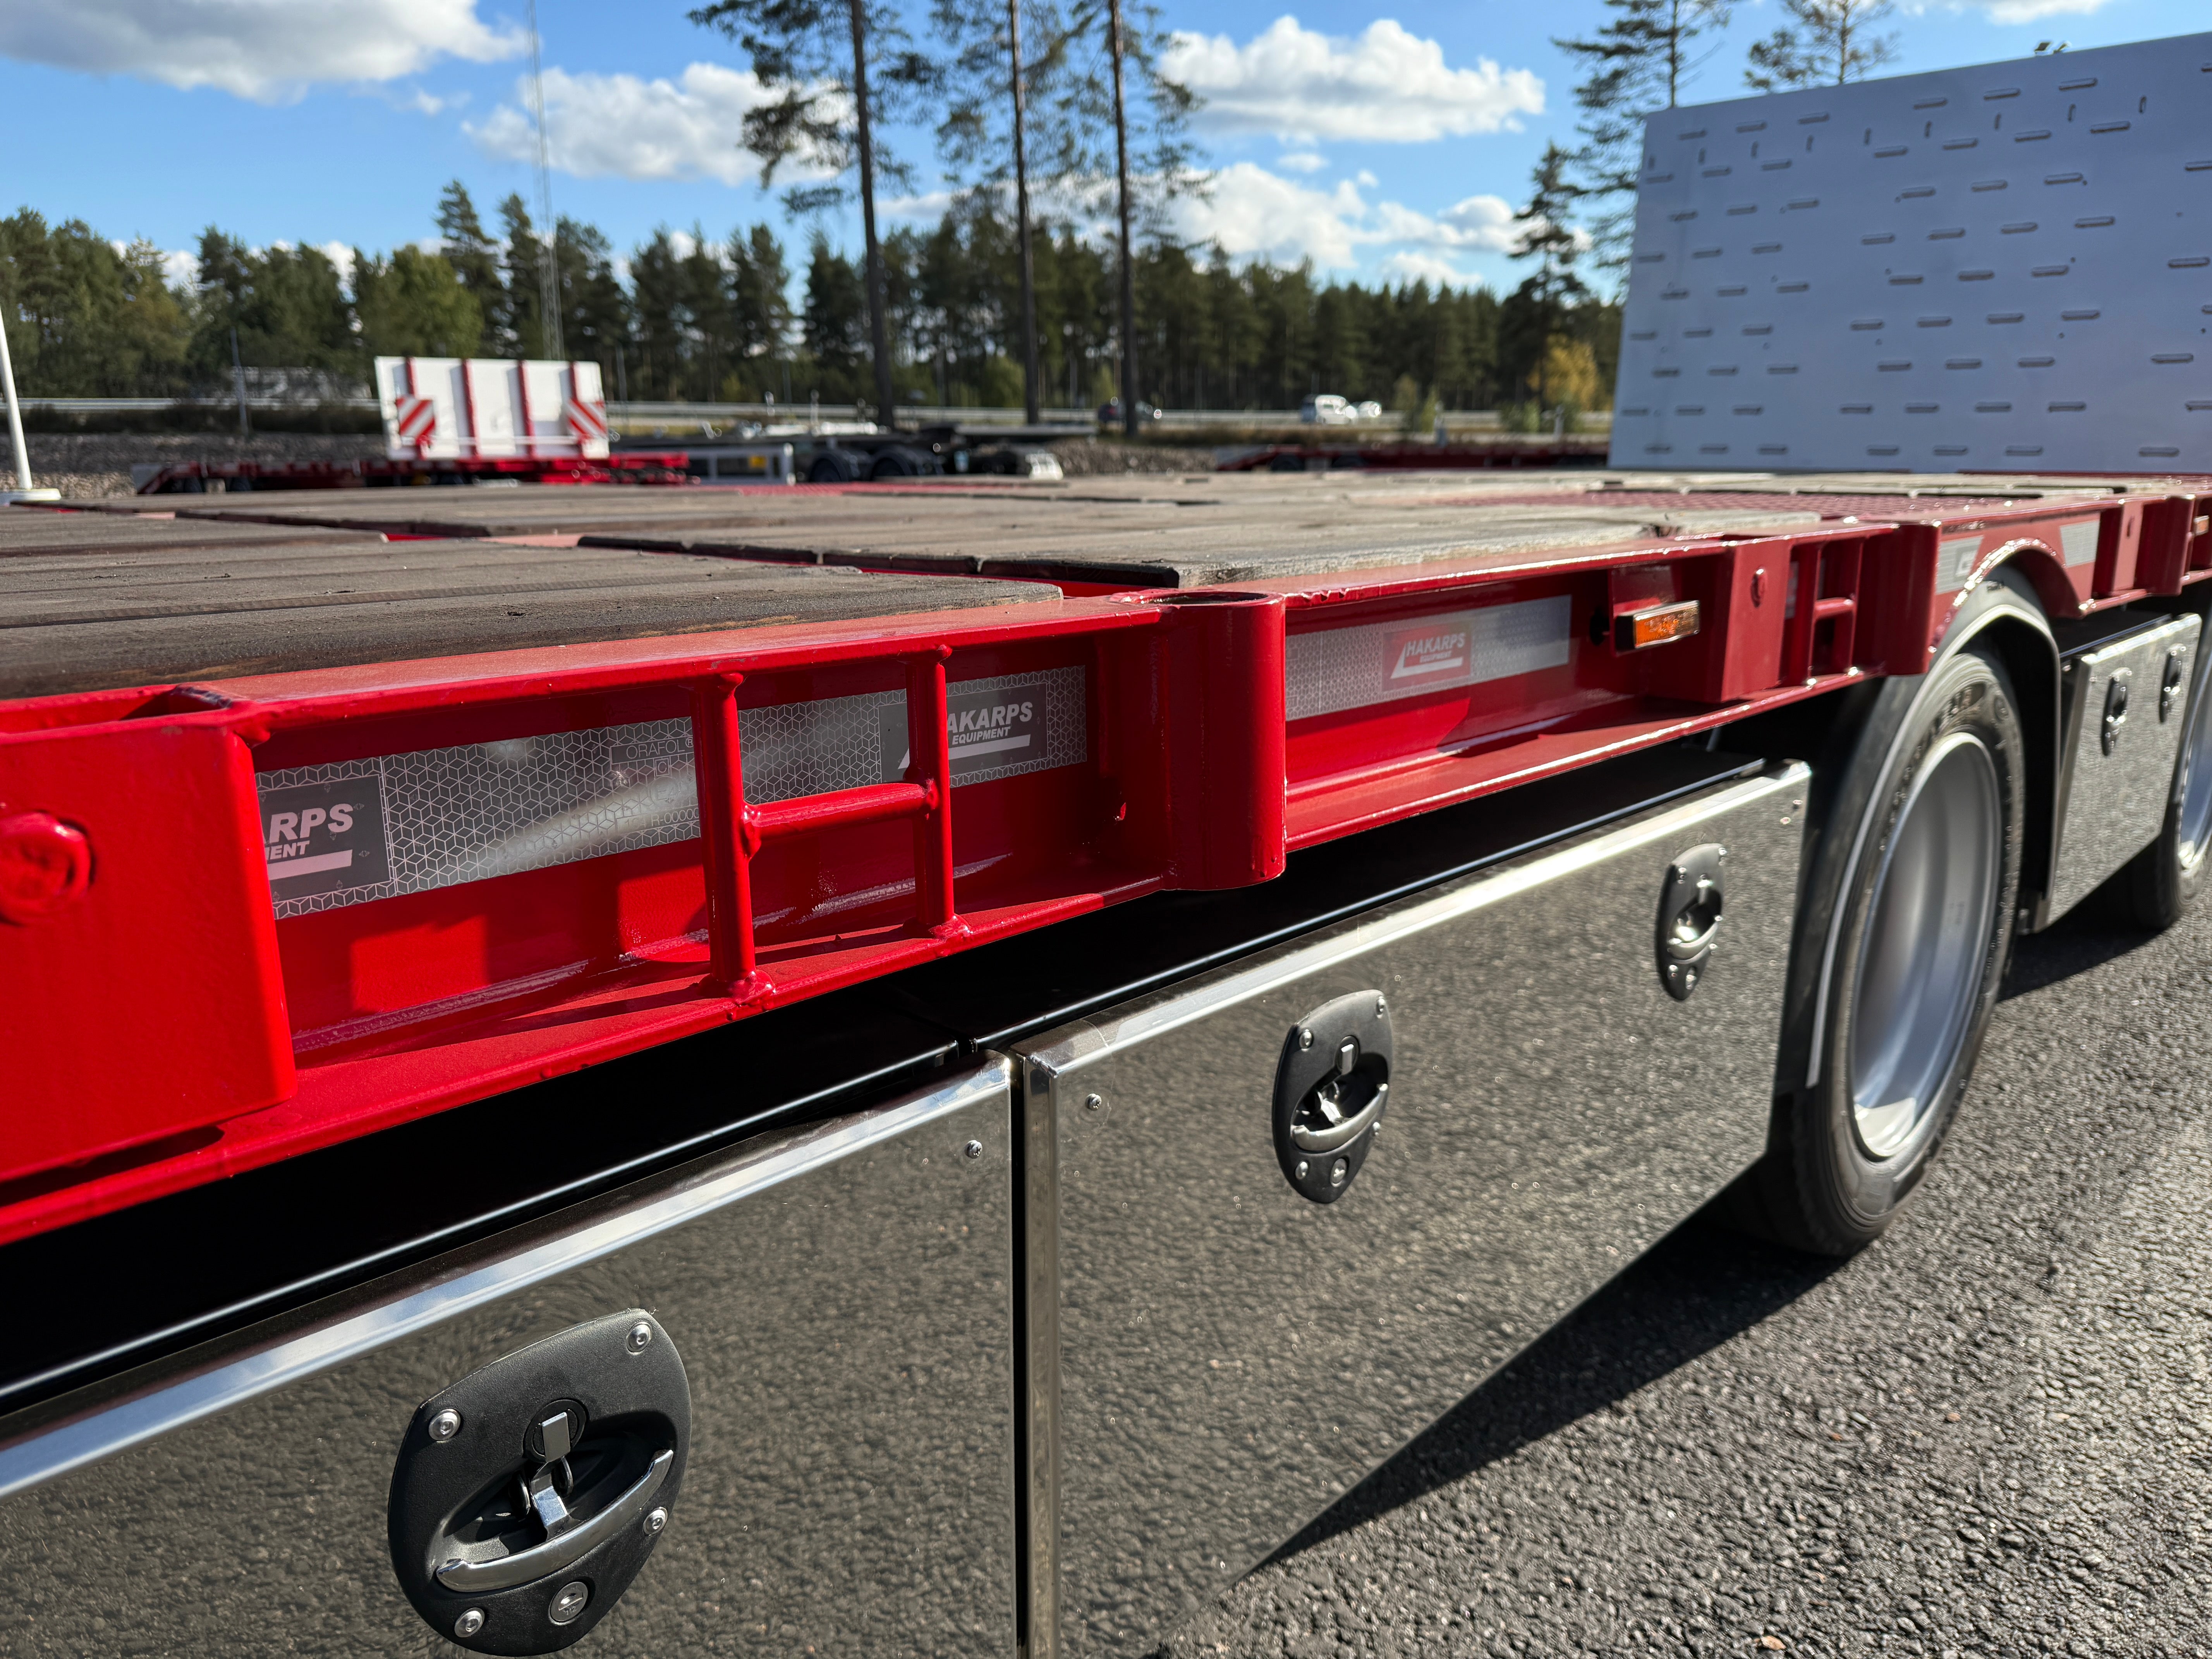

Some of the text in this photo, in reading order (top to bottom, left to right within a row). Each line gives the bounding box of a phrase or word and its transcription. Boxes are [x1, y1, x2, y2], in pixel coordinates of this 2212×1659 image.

[1406, 632, 1466, 657] HAKARPS
[947, 702, 1033, 733] AKARPS
[952, 726, 1011, 745] EQUIPMENT
[264, 803, 354, 845] RPS
